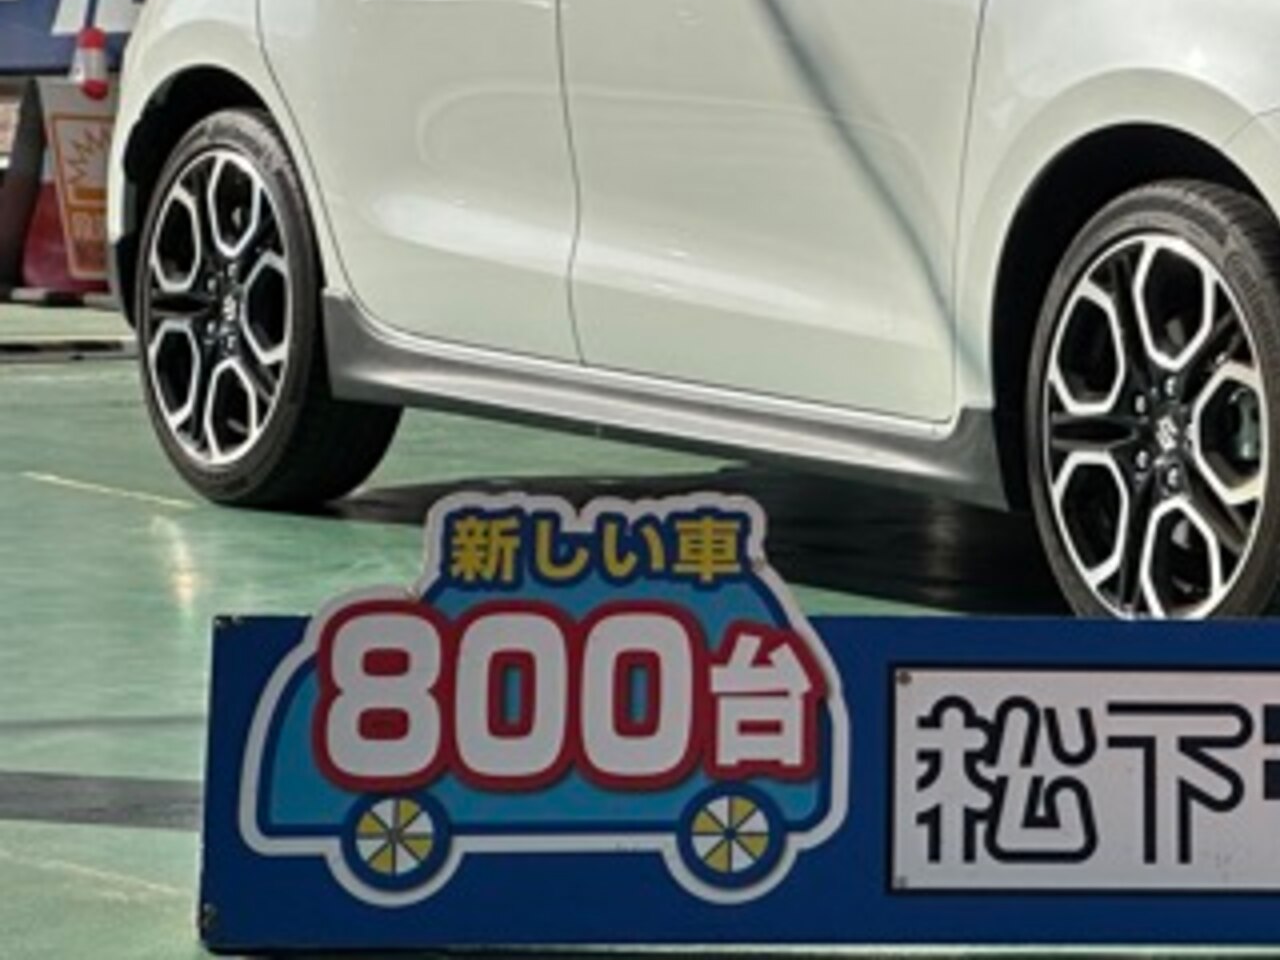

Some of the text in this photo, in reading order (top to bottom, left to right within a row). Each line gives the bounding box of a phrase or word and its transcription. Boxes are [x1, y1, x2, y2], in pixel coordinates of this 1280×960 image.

[449, 515, 742, 582] 新しい車
[324, 611, 813, 777] 800台
